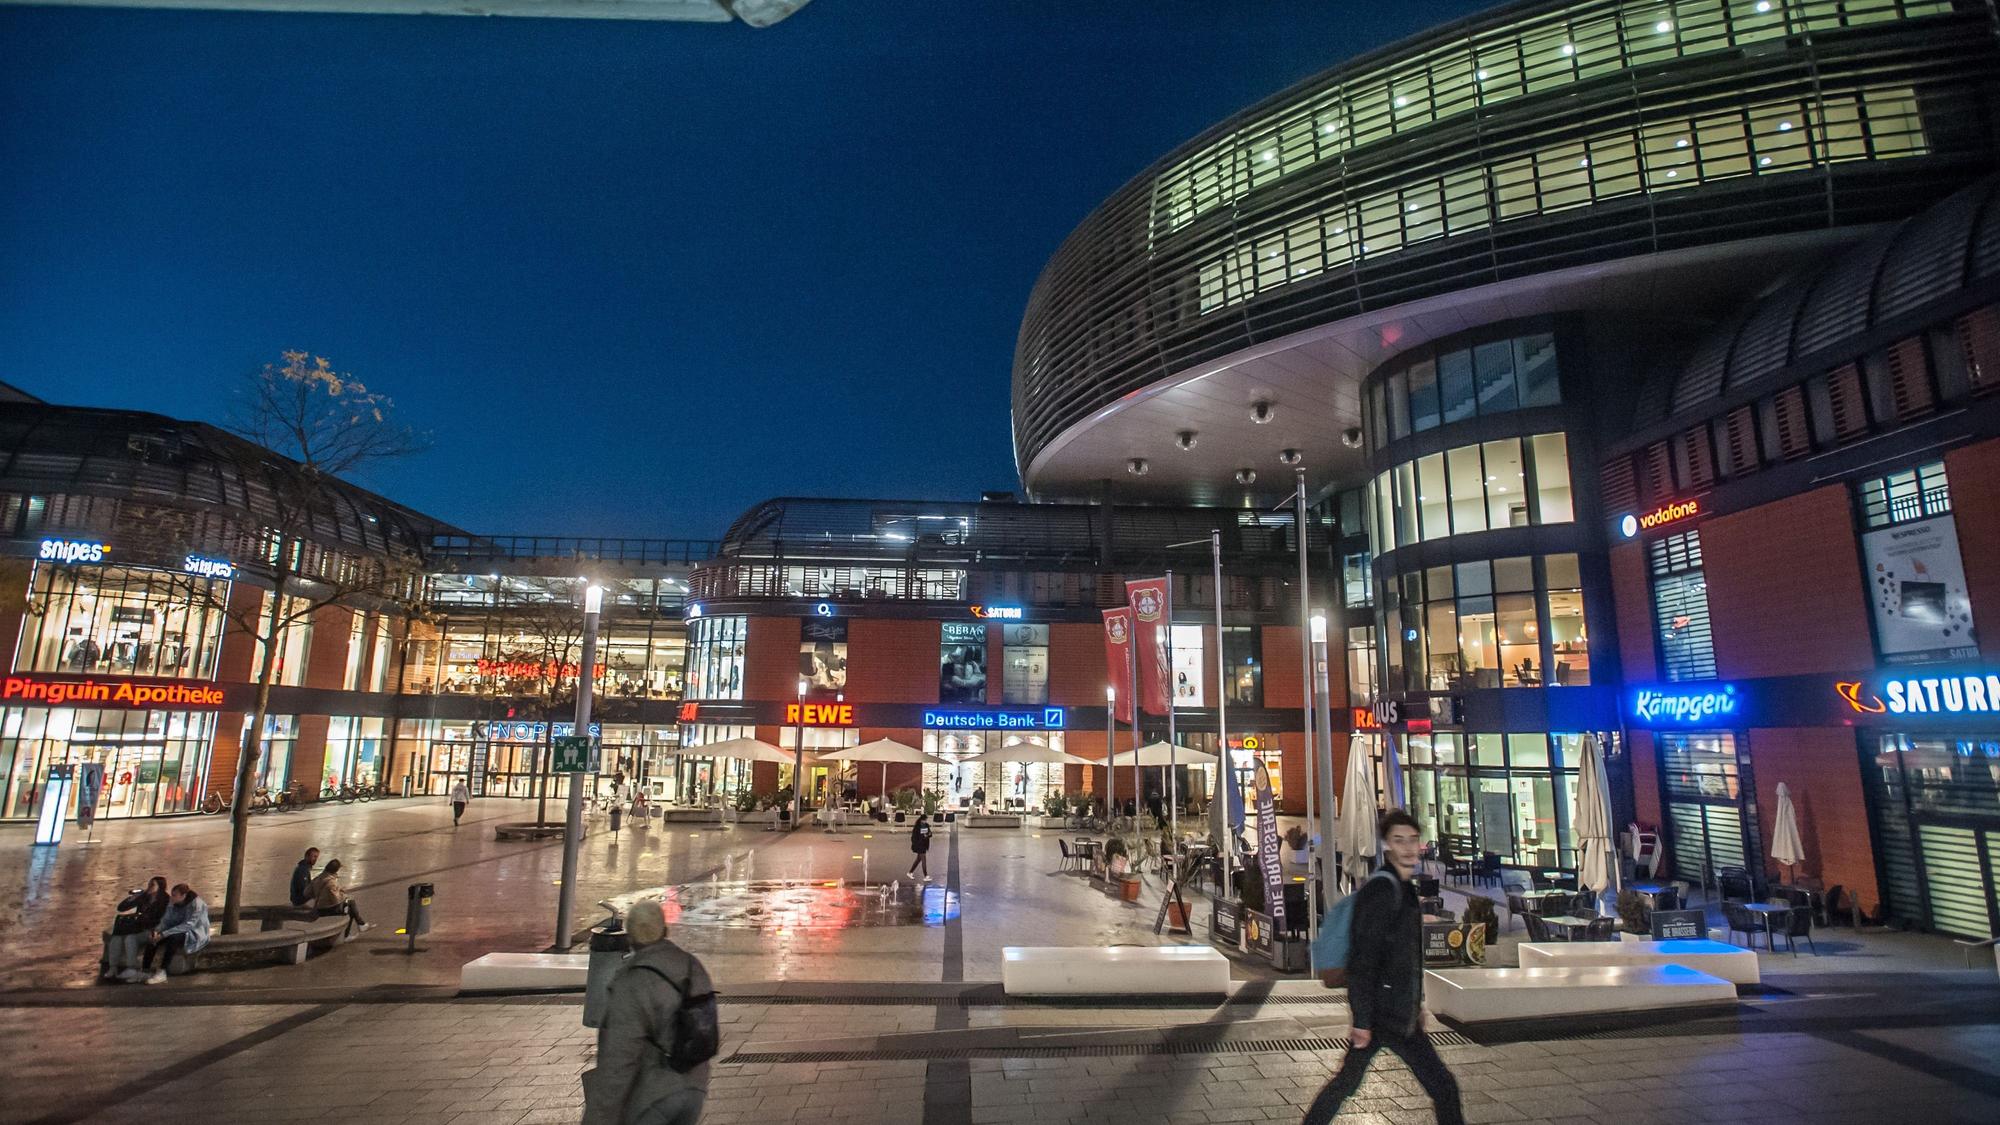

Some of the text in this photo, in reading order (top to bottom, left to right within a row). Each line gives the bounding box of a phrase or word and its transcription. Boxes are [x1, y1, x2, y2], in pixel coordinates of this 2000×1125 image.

[1640, 501, 1697, 529] vodafone
[40, 541, 103, 563] snipes
[987, 607, 1022, 619] SATURN
[4, 679, 224, 705] Pinguin Apotheke
[787, 704, 852, 724] REWE
[1636, 689, 1735, 720] Kämpgen
[925, 713, 1035, 727] Deutsche Bank
